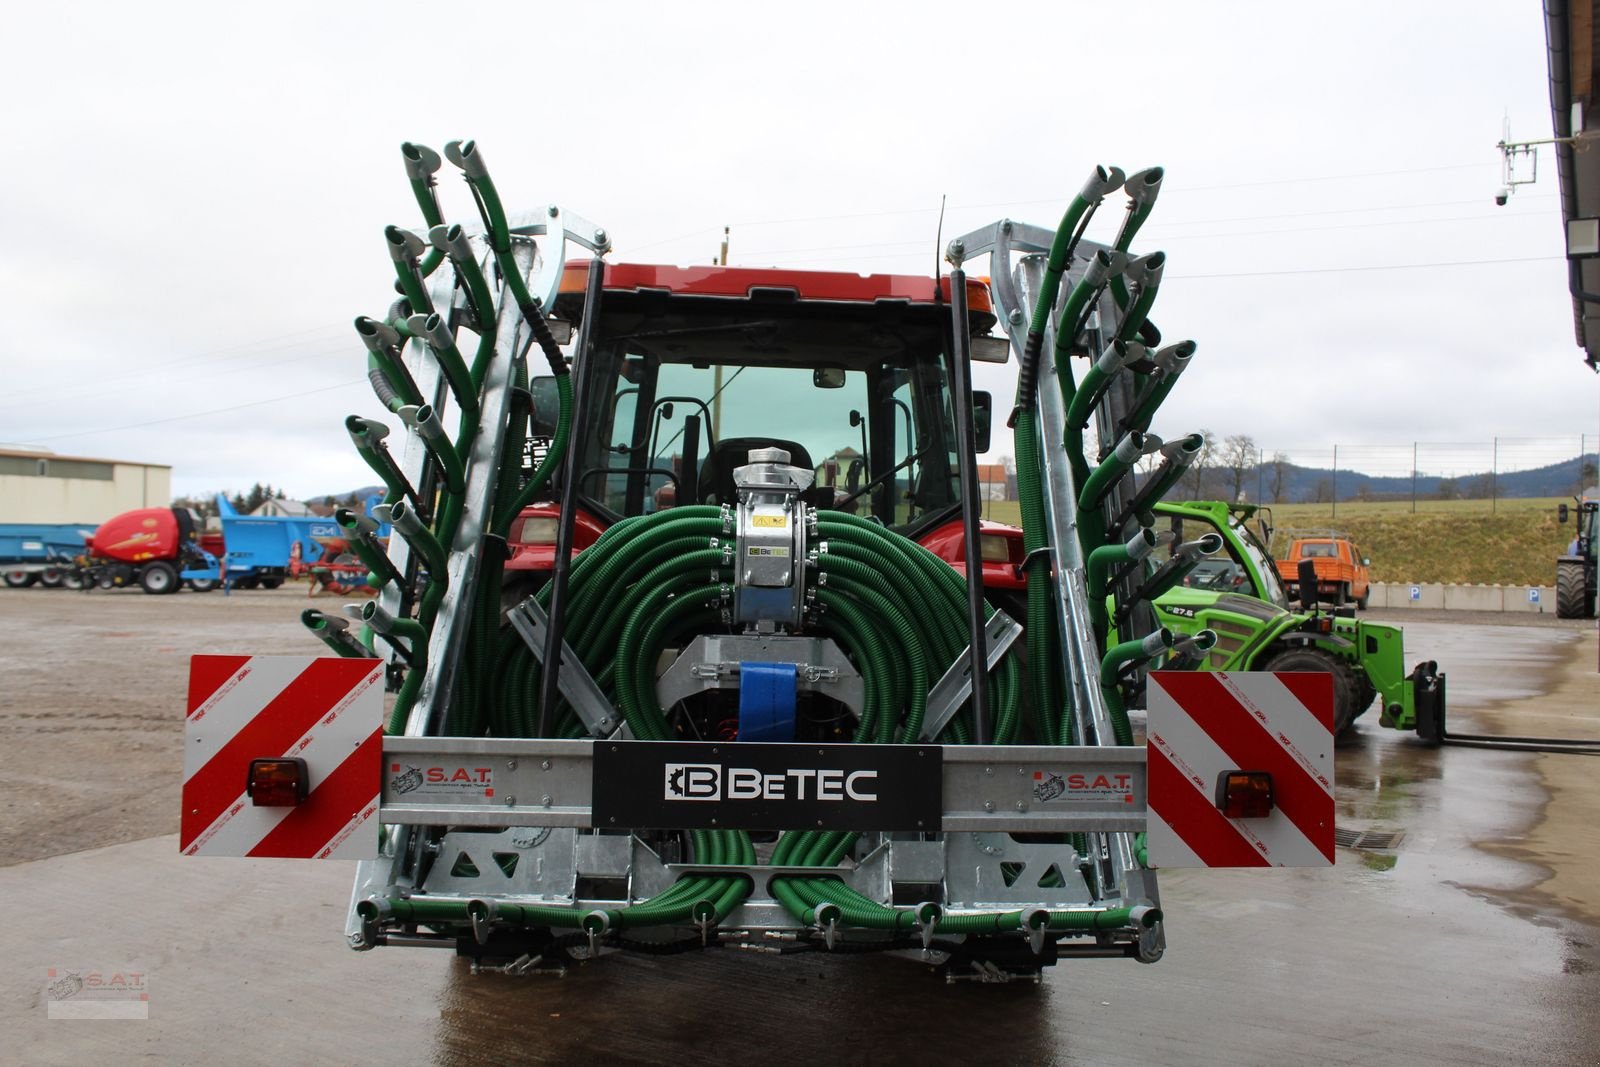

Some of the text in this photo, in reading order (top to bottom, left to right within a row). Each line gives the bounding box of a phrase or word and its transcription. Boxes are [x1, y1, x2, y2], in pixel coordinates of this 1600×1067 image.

[1410, 587, 1420, 599] P
[1529, 589, 1538, 602] P
[426, 767, 492, 782] S.A.T.
[1067, 774, 1131, 789] S.A.T.
